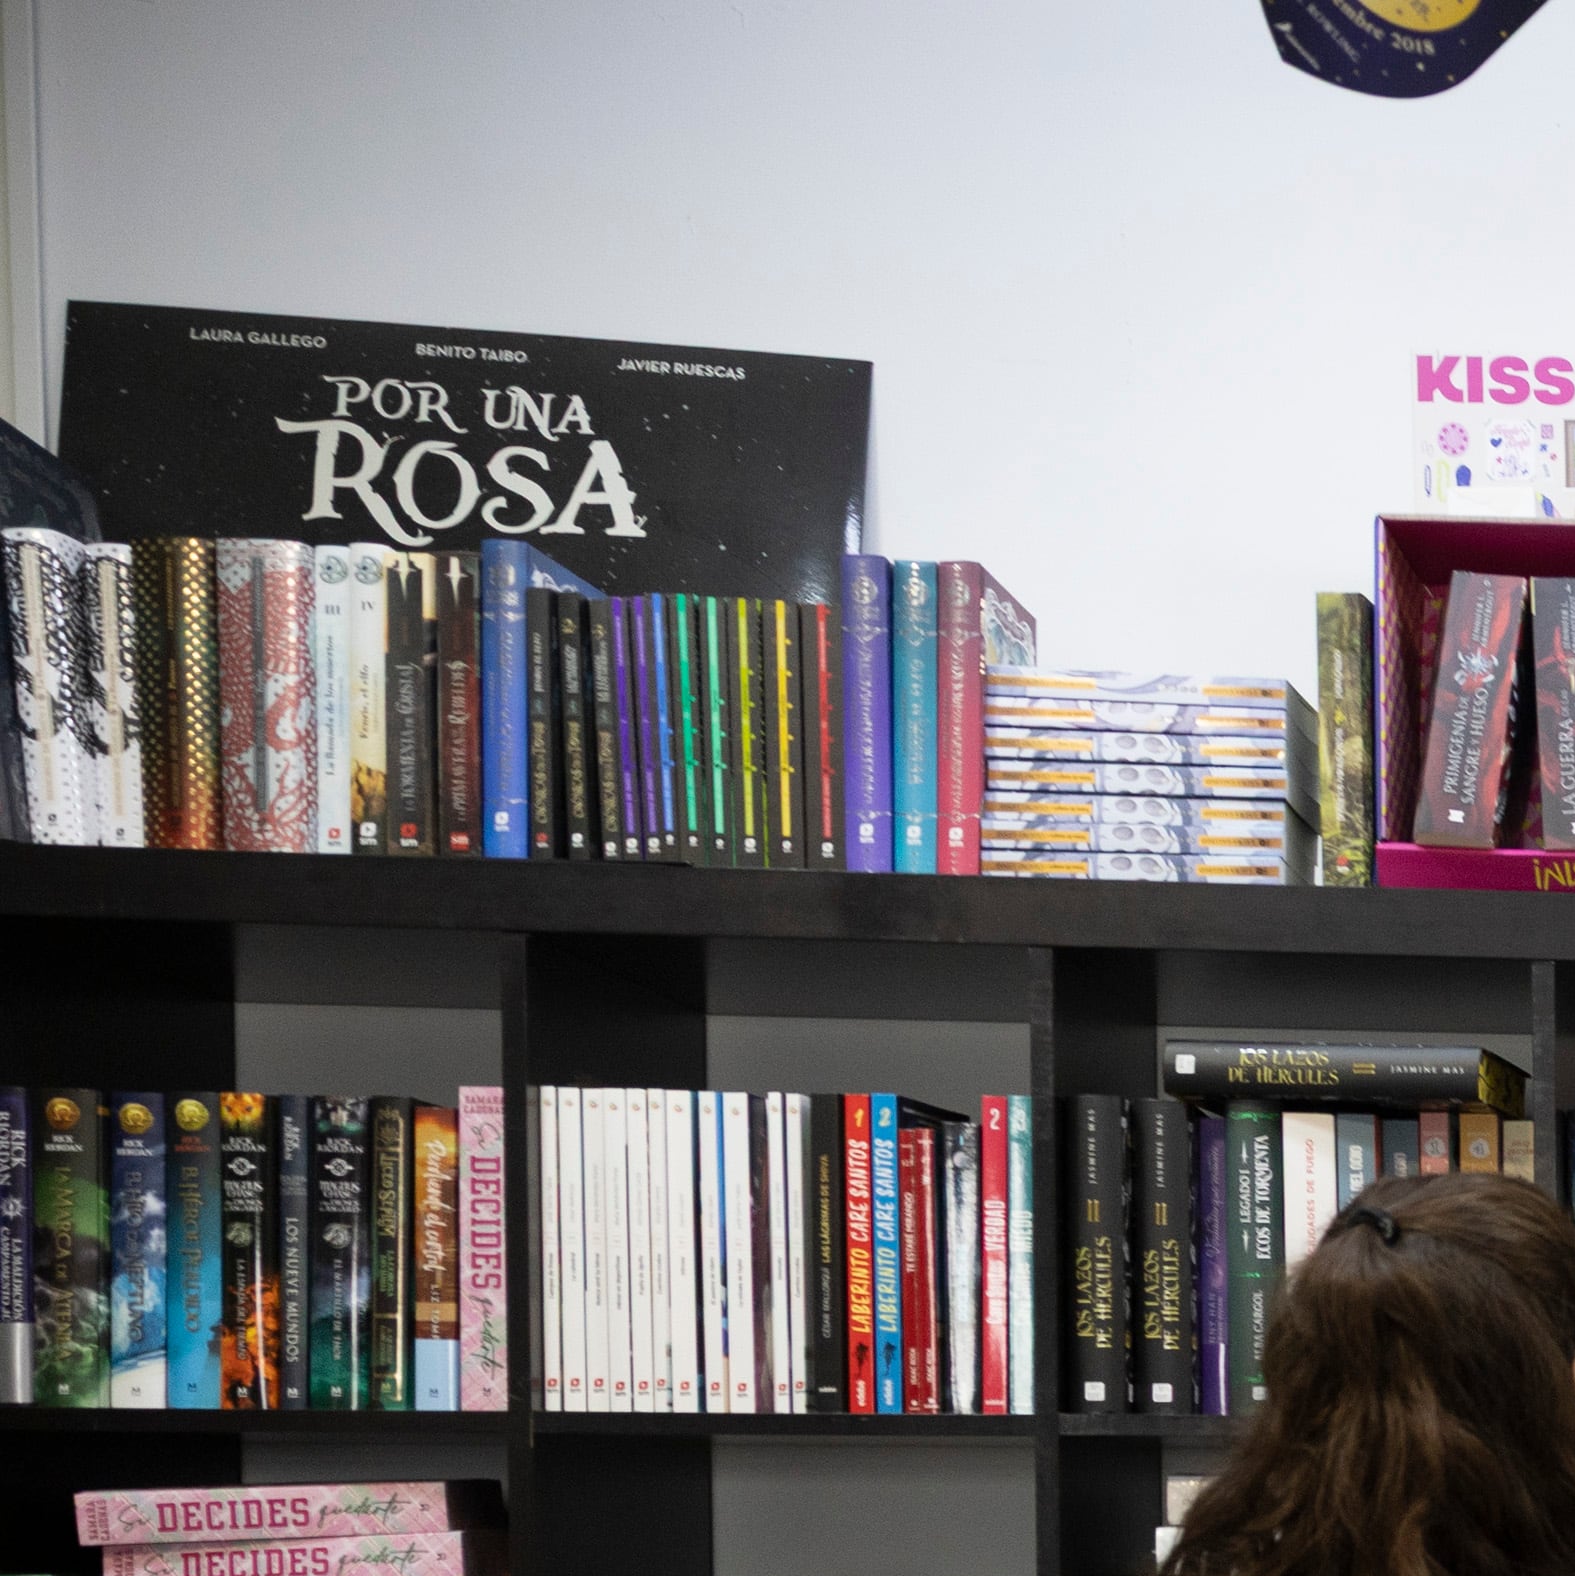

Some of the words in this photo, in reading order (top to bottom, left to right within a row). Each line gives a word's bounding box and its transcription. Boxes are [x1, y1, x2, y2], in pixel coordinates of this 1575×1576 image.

[1391, 32, 1435, 56] 2018
[190, 327, 244, 345] LAURA
[247, 332, 327, 349] GALLEGO
[416, 344, 475, 360] BENITO
[479, 348, 528, 363] TAIBO
[617, 358, 671, 375] JAVIER
[673, 363, 746, 381] RUESCAS
[1416, 356, 1575, 405] KISS
[323, 375, 468, 434] POR
[481, 386, 595, 441] UNA
[275, 416, 647, 547] ROSA
[1460, 742, 1482, 805] SANGRE
[1471, 687, 1489, 736] HUESO
[1558, 717, 1575, 790] GUERRA
[848, 1139, 869, 1199] SANTOS
[874, 1139, 895, 1199] SANTOS
[1254, 1135, 1272, 1202] TORMENTA
[285, 1217, 300, 1243] LOS
[470, 1157, 502, 1289] DECIDES
[849, 1203, 869, 1242] CARE
[876, 1203, 896, 1242] CARE
[1256, 1206, 1272, 1225] DE
[1256, 1228, 1272, 1260] ECOS
[285, 1250, 300, 1296] NUEVE
[850, 1248, 872, 1334] LABERINTO
[877, 1248, 898, 1334] LABERINTO
[1076, 1246, 1093, 1305] LAZOS
[1094, 1236, 1112, 1320] HÉRCULES
[284, 1301, 299, 1363] MUNDOS
[1077, 1308, 1093, 1337] LOS
[1096, 1328, 1113, 1348] DE
[156, 1498, 310, 1533] DECIDES
